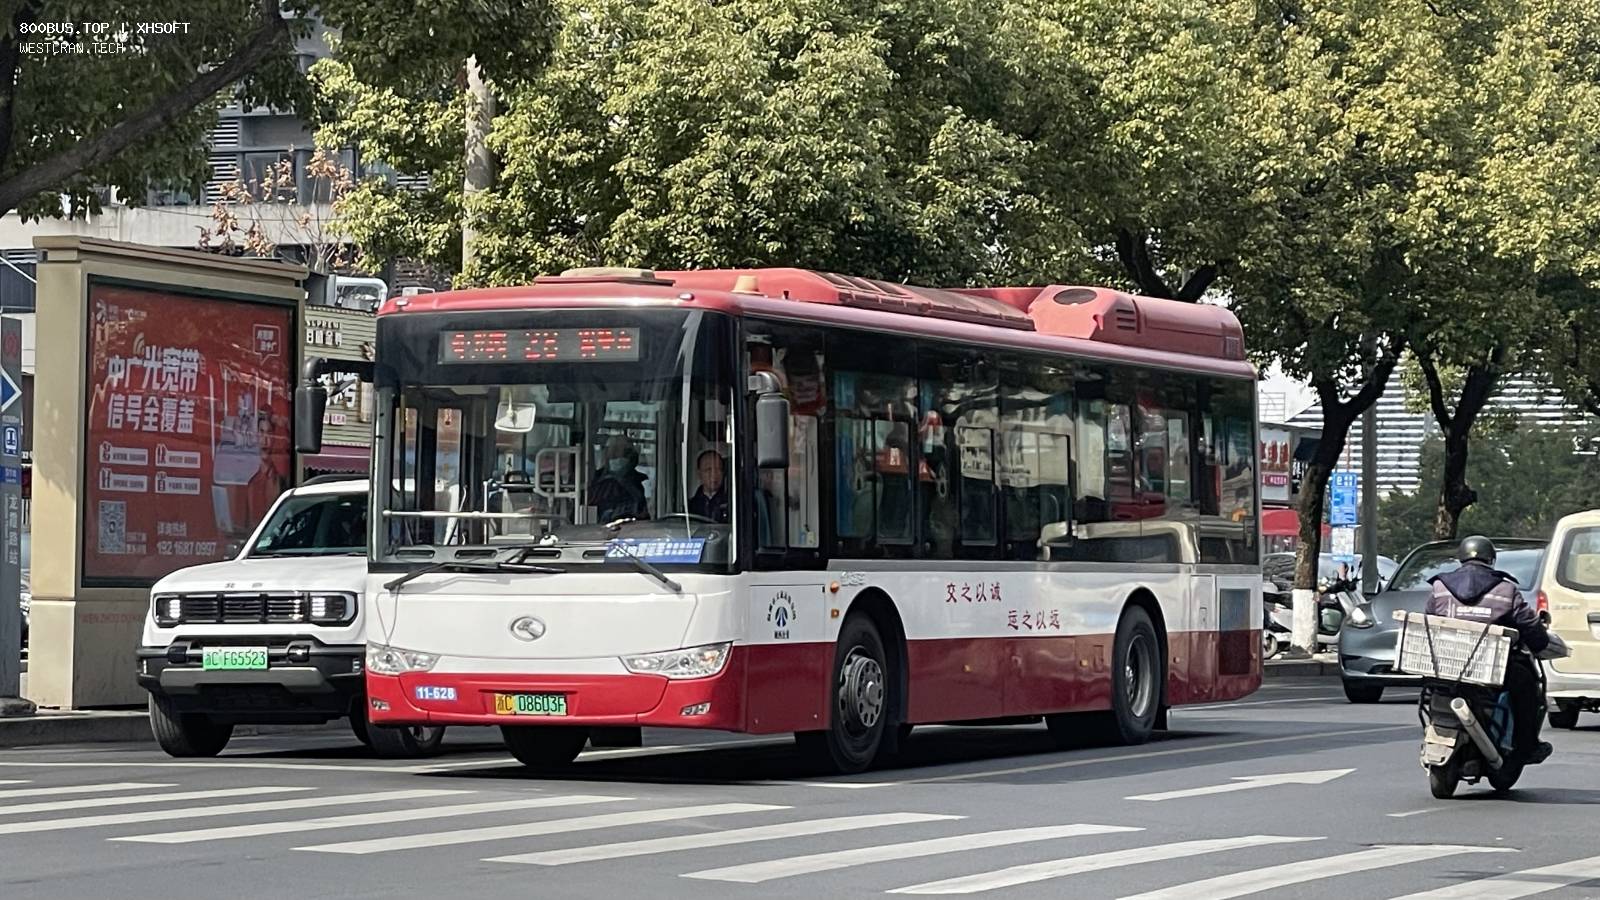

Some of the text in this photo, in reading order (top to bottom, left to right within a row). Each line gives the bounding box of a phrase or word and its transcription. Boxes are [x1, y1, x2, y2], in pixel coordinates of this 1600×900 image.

[108, 346, 200, 392] 中广光宽带
[107, 393, 195, 433] 信号全覆盖
[946, 582, 1001, 602] 交之以诚
[1008, 609, 1060, 630] 运之以远
[224, 650, 265, 666] FG5523
[518, 696, 565, 712] 08603F
